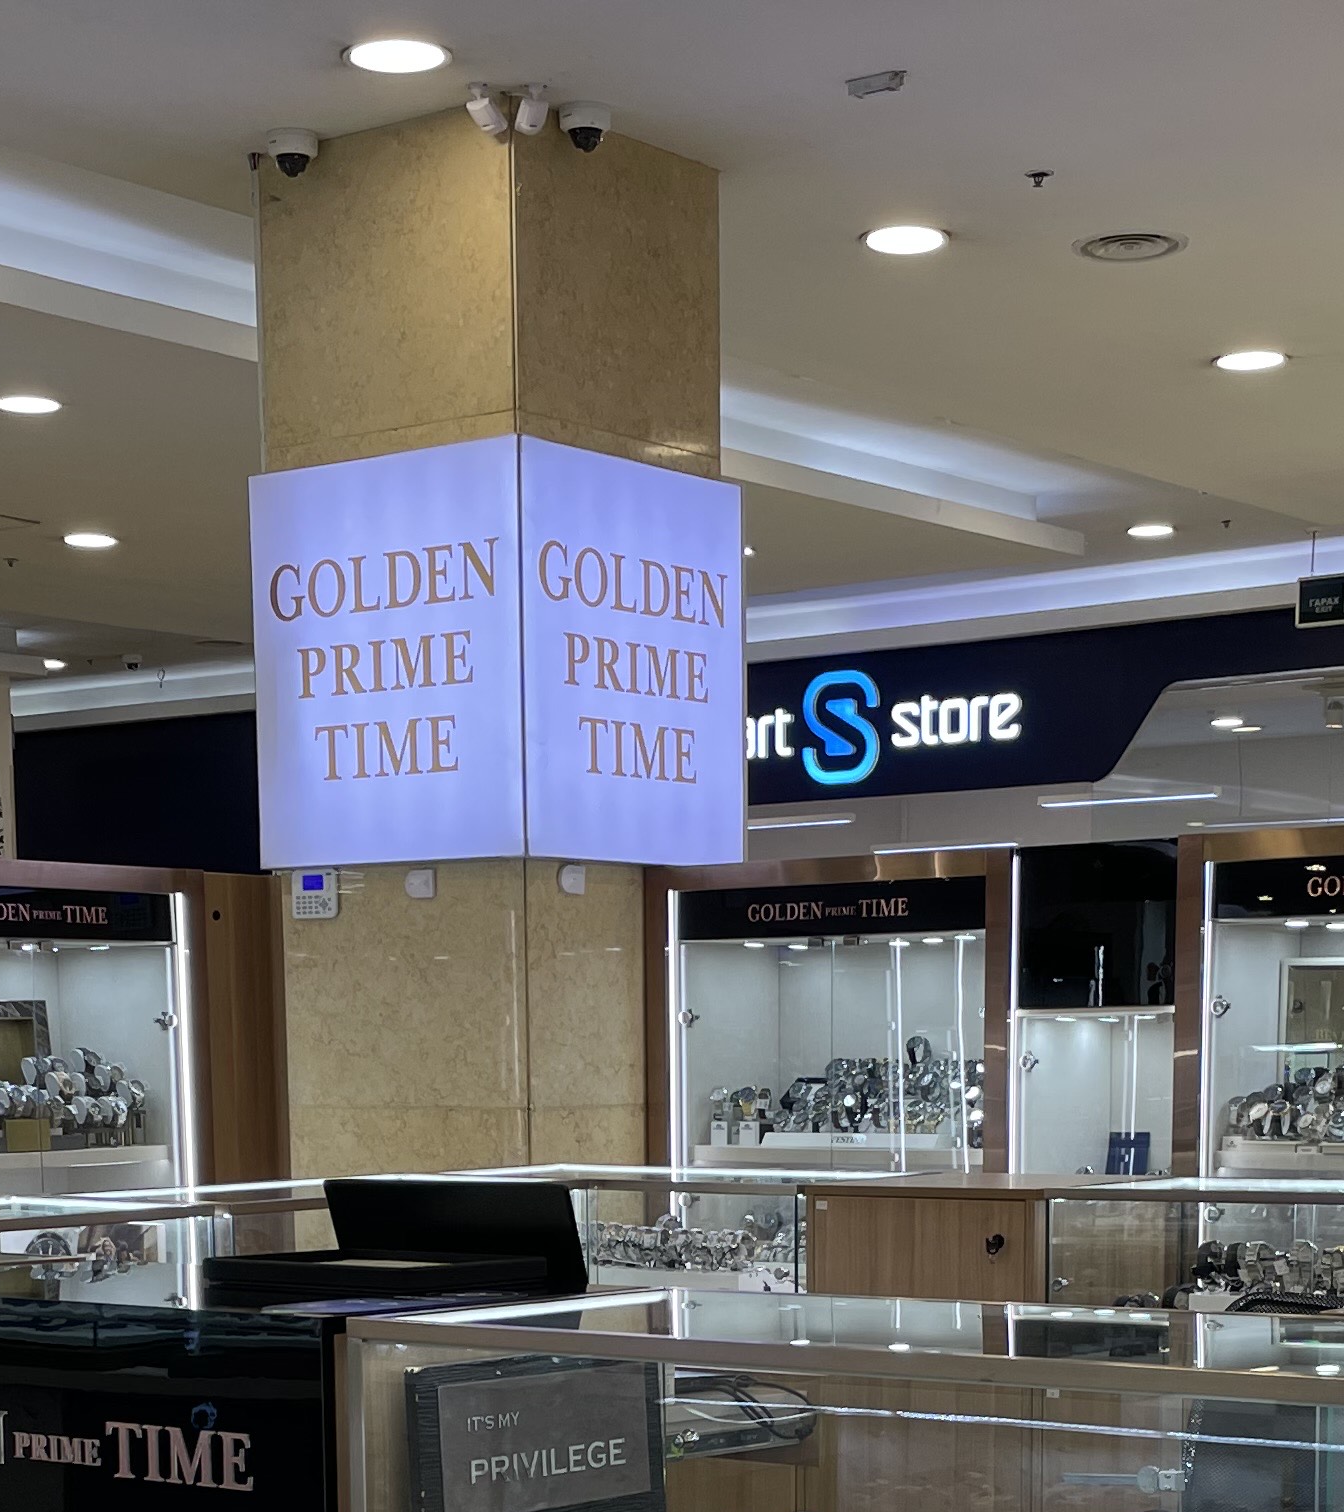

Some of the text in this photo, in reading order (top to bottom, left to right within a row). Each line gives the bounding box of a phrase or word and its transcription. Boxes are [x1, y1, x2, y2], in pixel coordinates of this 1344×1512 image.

[269, 536, 499, 622] GOLDEN
[538, 540, 728, 628] GOLDEN
[298, 630, 473, 699] PRIME
[563, 632, 709, 703] PRIME
[315, 715, 459, 781] TIME
[579, 716, 697, 783] TIME
[891, 692, 1022, 748] store
[33, 909, 62, 921] PRIME
[63, 905, 108, 924] TIME
[748, 897, 909, 922] GOLDEN PRIME TIME
[467, 1412, 520, 1432] IT'S MY
[13, 1431, 102, 1468] PRIME
[105, 1420, 254, 1492] TIME
[470, 1438, 627, 1485] PRIVILEGE
